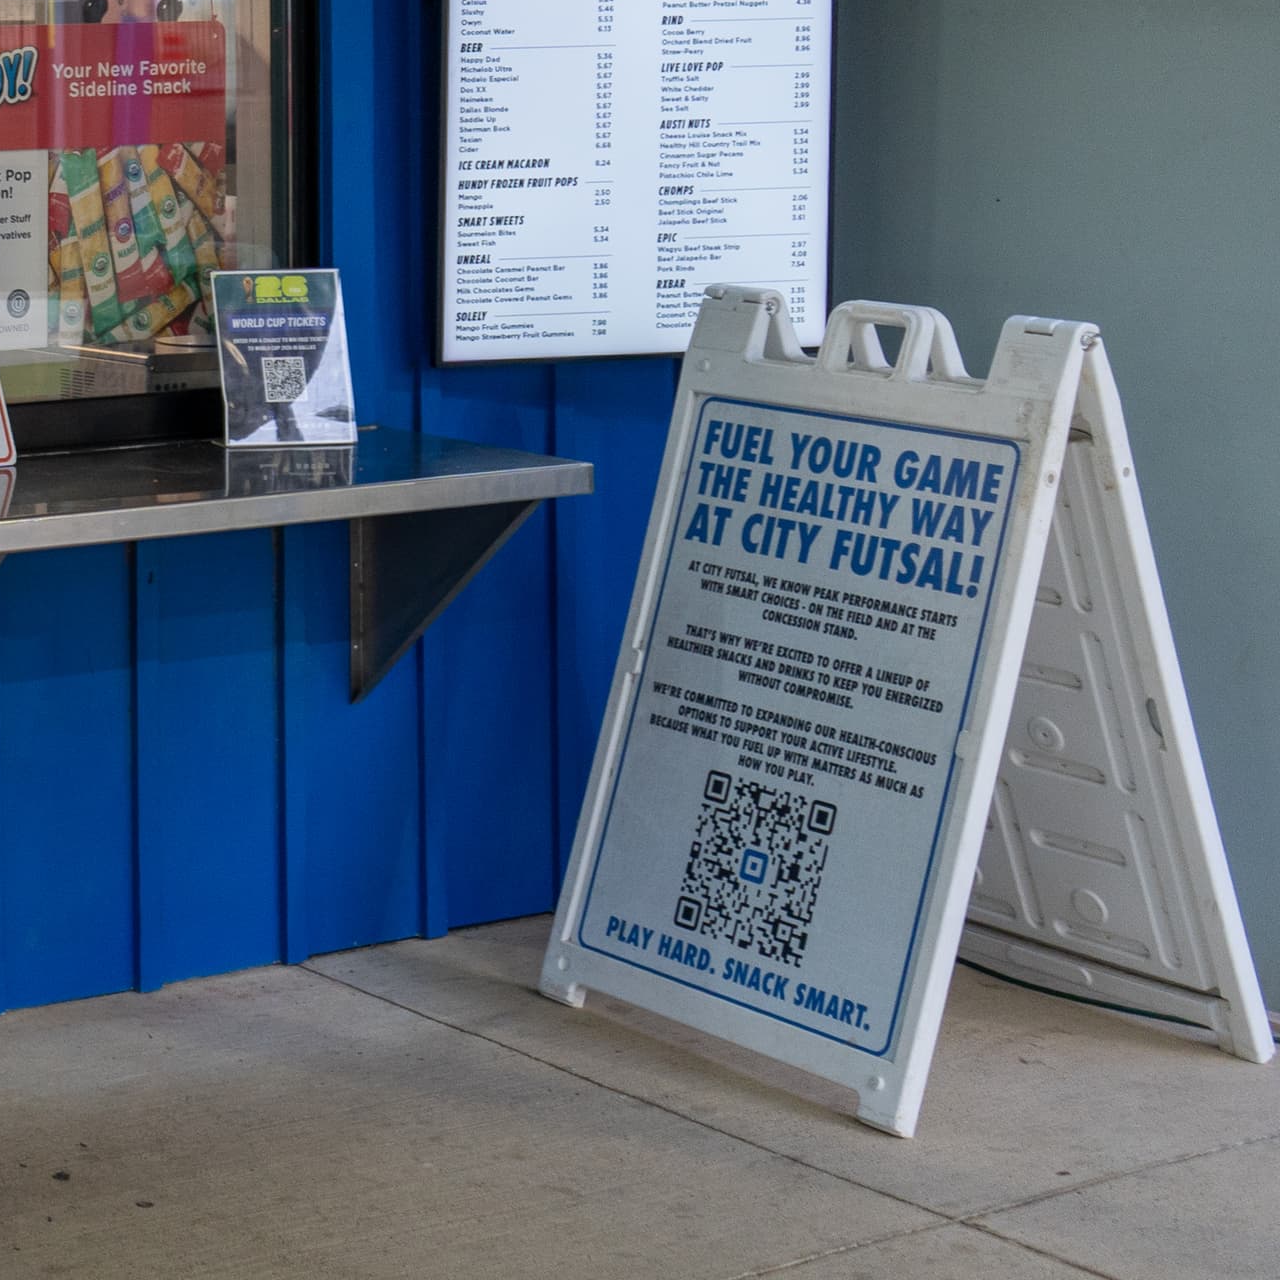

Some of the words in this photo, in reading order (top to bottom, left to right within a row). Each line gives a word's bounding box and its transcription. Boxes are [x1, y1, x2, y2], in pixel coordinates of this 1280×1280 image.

[662, 16, 683, 25] RIND
[461, 44, 483, 53] BEER
[53, 64, 91, 79] Your
[97, 62, 134, 77] New
[140, 60, 206, 75] Favorite
[661, 63, 679, 72] LIVE
[682, 63, 703, 72] LOVE
[706, 62, 723, 71] POP
[69, 81, 137, 98] Sideline
[143, 79, 191, 94] Snack
[459, 161, 472, 170] ICE
[475, 160, 504, 169] CREAM
[507, 158, 550, 168] MACARON
[6, 170, 32, 185] Pop
[459, 180, 488, 190] HUNDY
[491, 179, 525, 189] FROZEN
[528, 178, 552, 187] FRUIT
[555, 177, 578, 186] POPS
[659, 186, 694, 196] CHOMPS
[458, 217, 487, 227] SMART
[490, 216, 524, 225] SWEETS
[657, 233, 677, 242] EPIC
[457, 255, 491, 264] UNREAL
[656, 279, 685, 289] RXBAR
[456, 312, 487, 321] SOLELY
[232, 318, 264, 328] WORLD
[268, 318, 285, 328] CUP
[288, 317, 326, 327] TICKETS
[703, 421, 774, 464] FUEL
[788, 432, 881, 483] YOUR
[894, 450, 1004, 503] GAME
[697, 462, 752, 501] THE
[760, 473, 900, 529] HEALTHY
[911, 498, 993, 547] WAY
[685, 503, 732, 546] AT
[742, 513, 822, 563] CITY
[830, 530, 984, 598] FUTSAL!
[688, 560, 702, 571] AT
[703, 562, 722, 575] CITY
[725, 568, 760, 585] FUTSAL,
[763, 576, 778, 589] WE
[780, 578, 811, 596] KNOW
[814, 586, 839, 601] PEAK
[842, 592, 918, 619] PERFORMANCE
[920, 608, 958, 627] STARTS
[606, 916, 654, 950] PLAY
[658, 934, 714, 974] HARD.
[722, 958, 790, 1000] SNACK
[794, 983, 870, 1031] SMART.
